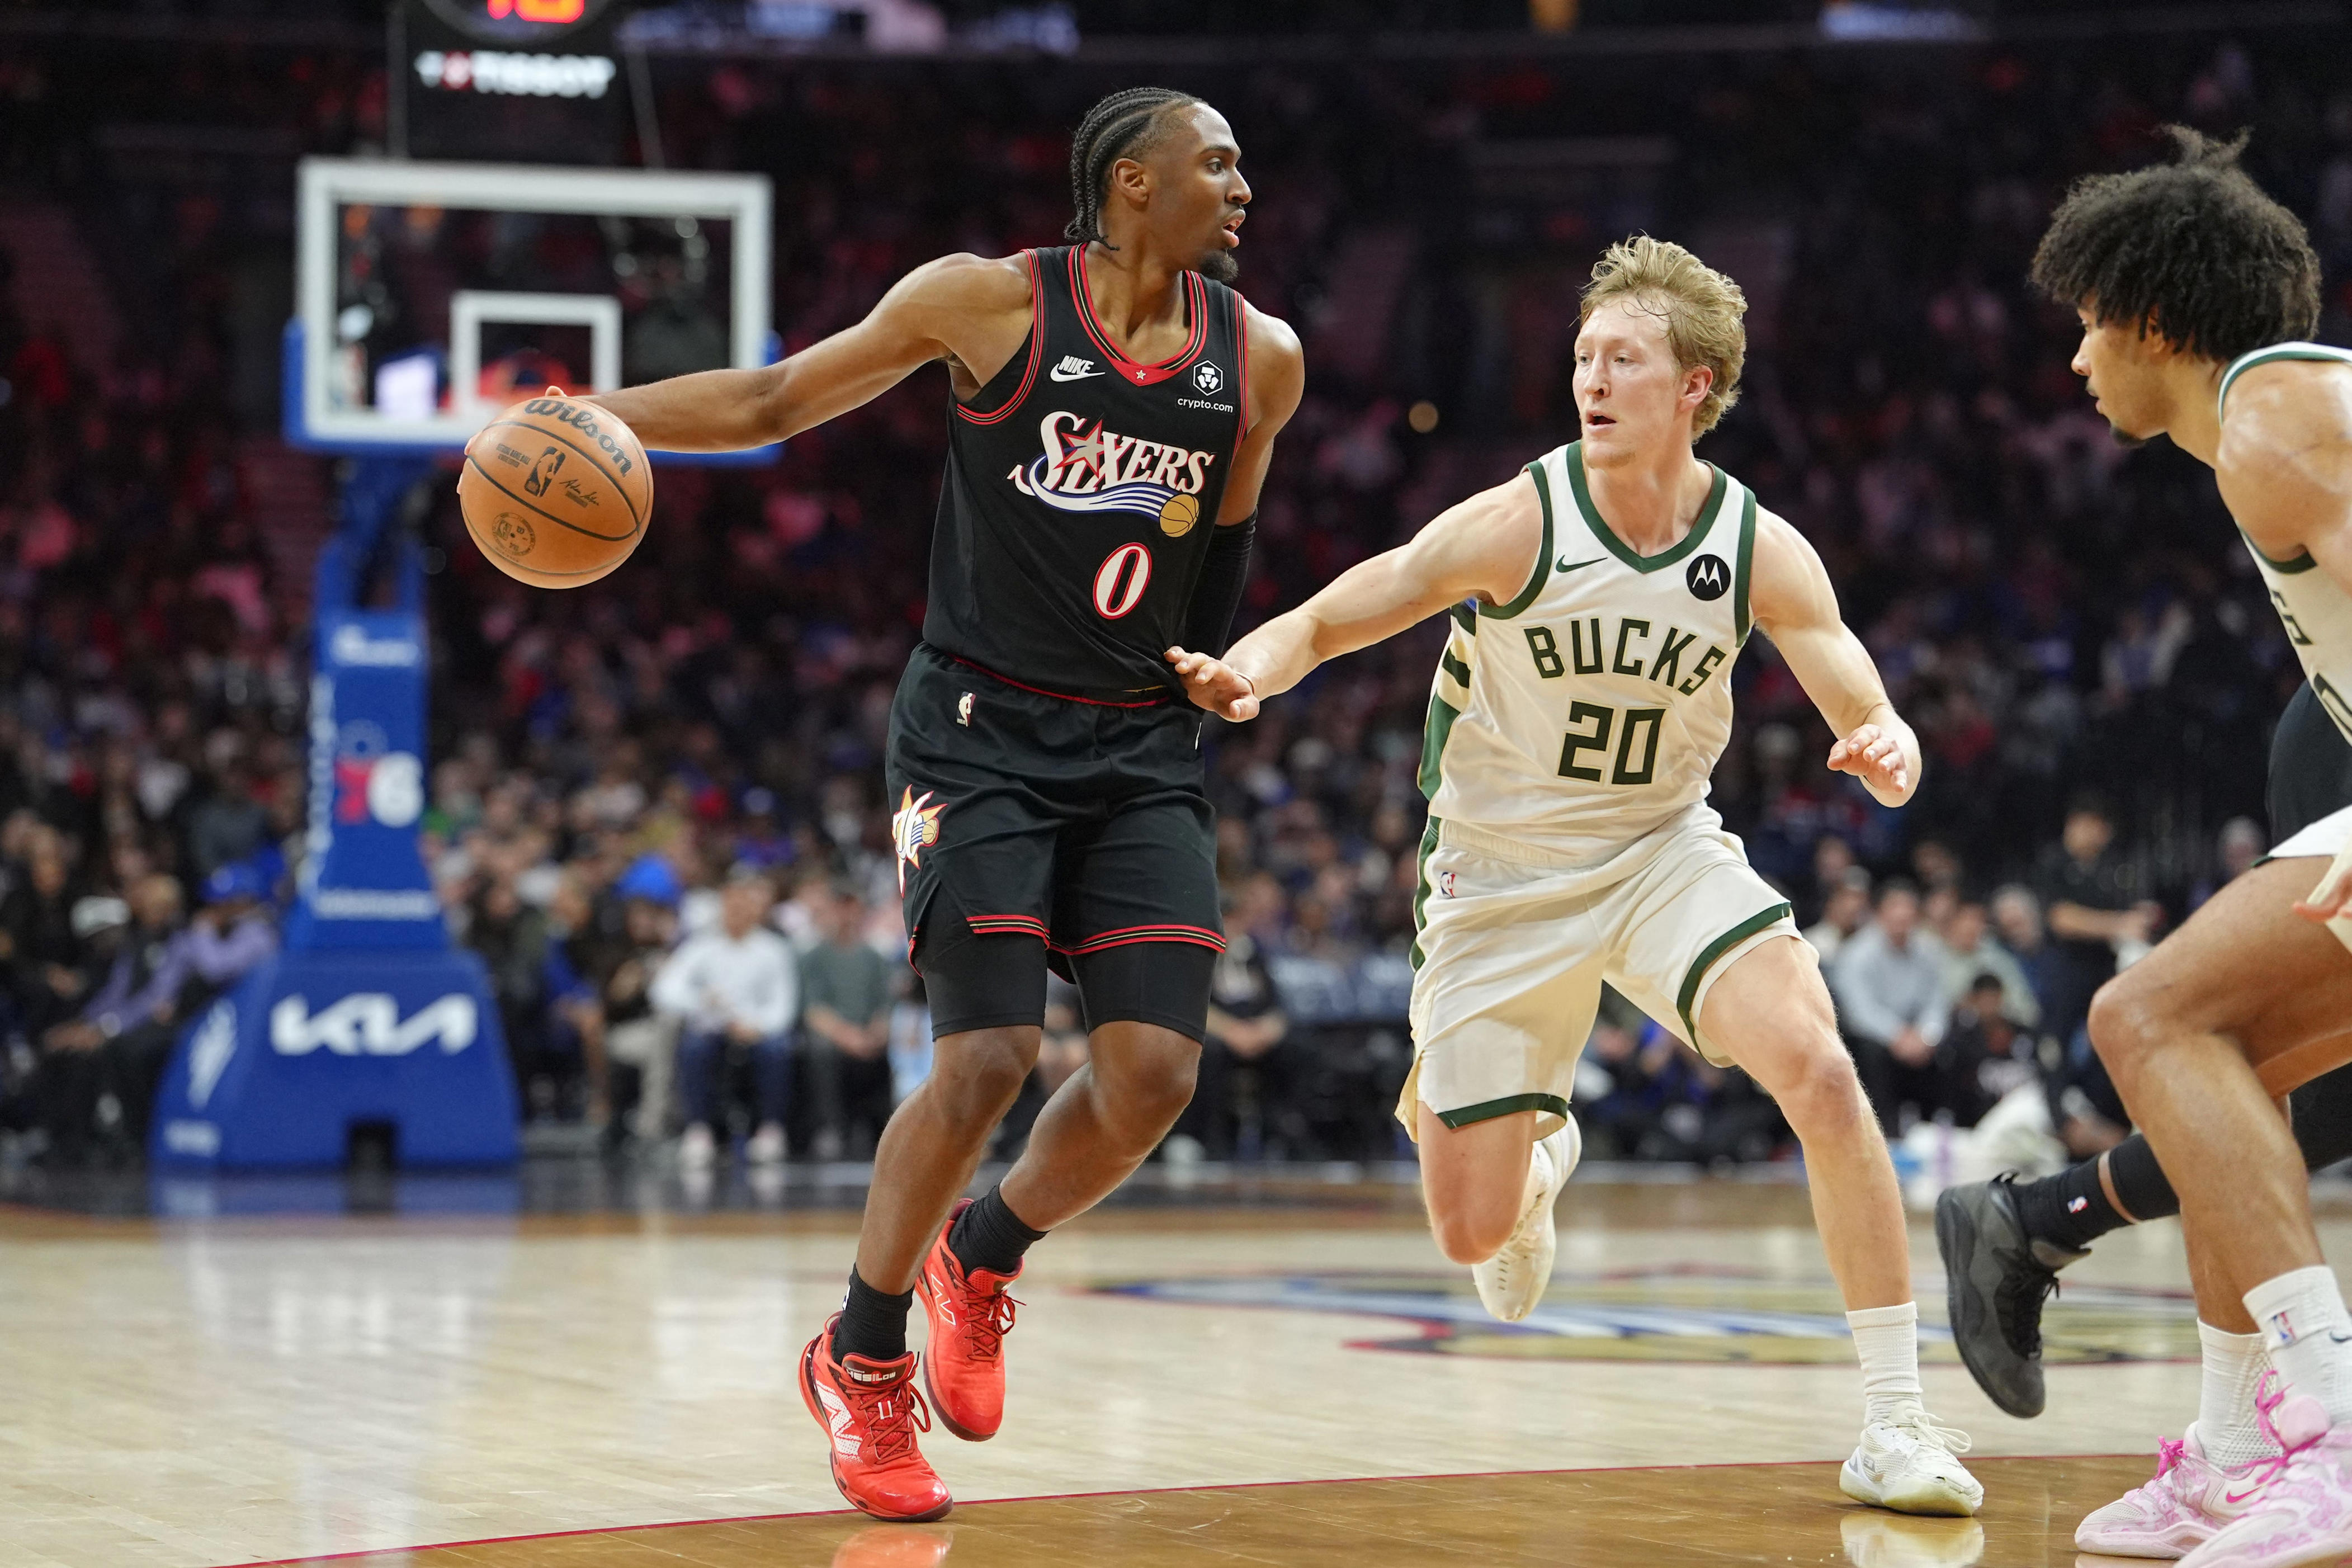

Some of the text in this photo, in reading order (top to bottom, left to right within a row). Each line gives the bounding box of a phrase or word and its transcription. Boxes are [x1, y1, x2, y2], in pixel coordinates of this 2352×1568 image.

[1059, 355, 1094, 375] NIKE
[524, 399, 632, 477] Wilson
[1177, 398, 1234, 414] crypto.com
[1093, 542, 1153, 620] 0
[1523, 618, 1727, 696] BUCKS
[1557, 700, 1666, 785] 20
